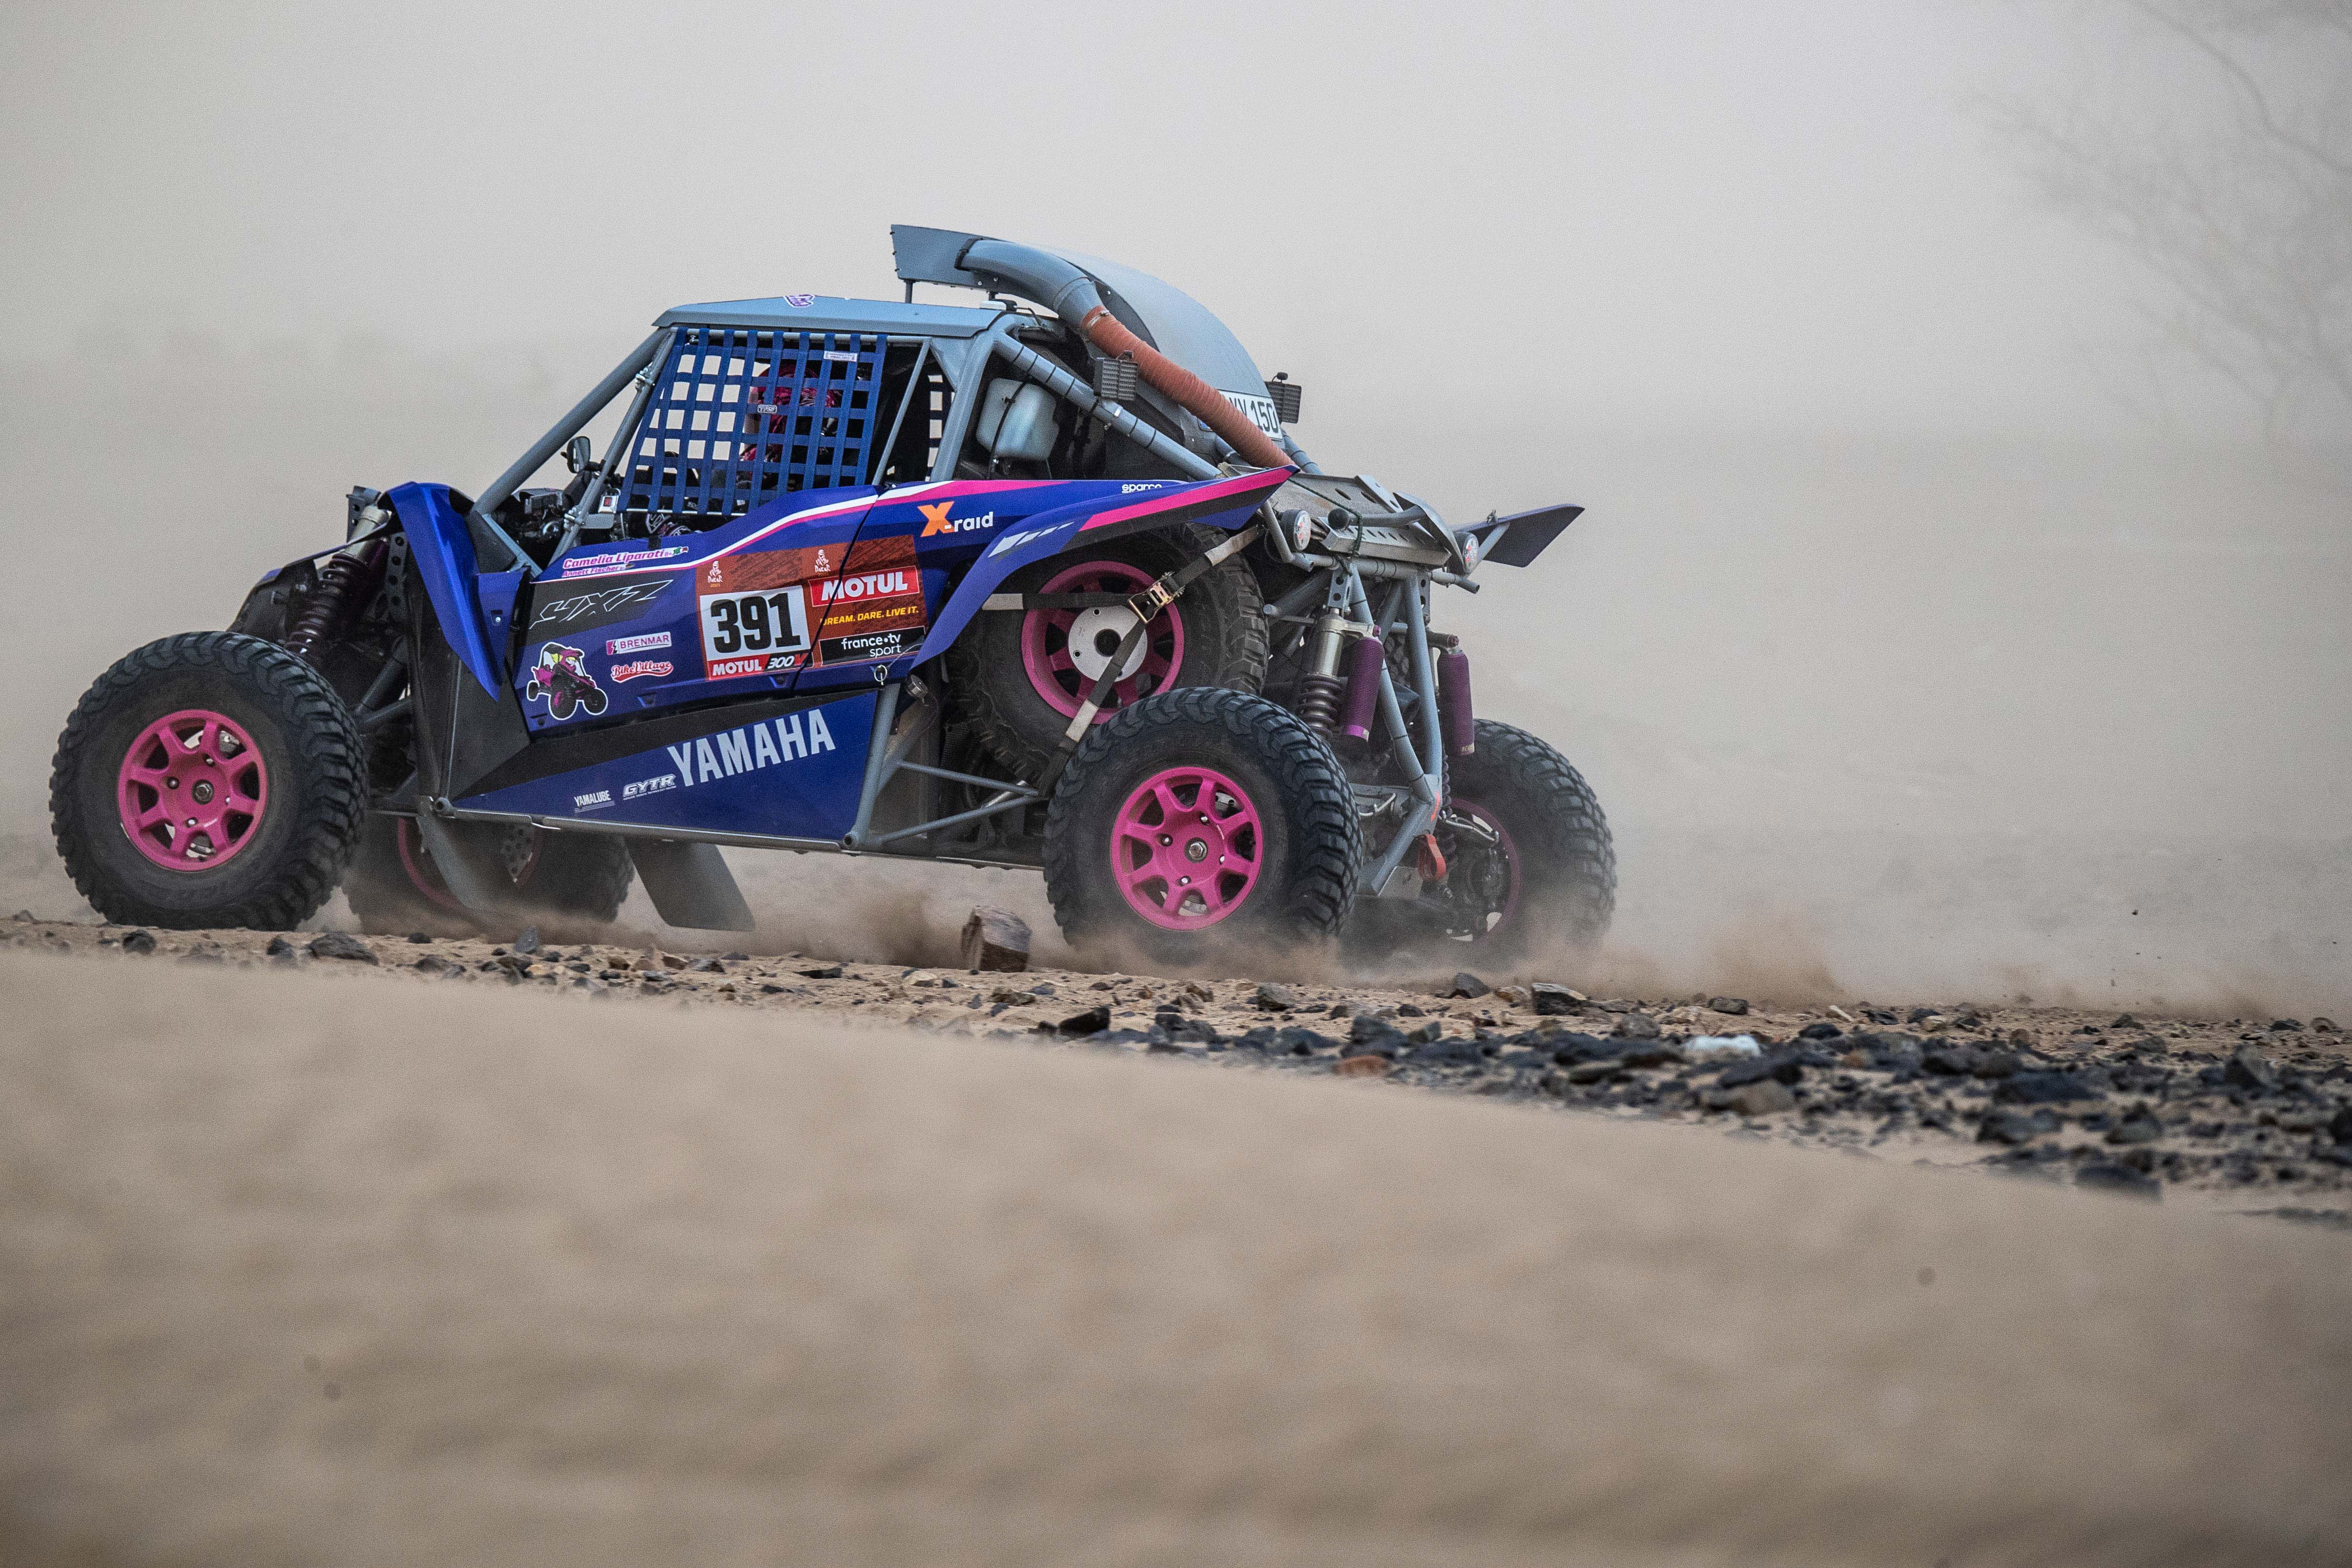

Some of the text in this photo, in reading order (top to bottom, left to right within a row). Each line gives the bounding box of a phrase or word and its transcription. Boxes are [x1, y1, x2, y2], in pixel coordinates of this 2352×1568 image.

[1250, 400, 1279, 433] 150
[917, 501, 993, 537] X-raid
[564, 555, 613, 568] Camelia
[821, 571, 908, 601] MOTUL
[711, 592, 802, 653] 391
[857, 610, 884, 621] DARE.
[886, 607, 906, 617] LIVE
[908, 606, 918, 614] IT.
[620, 635, 670, 649] BRENMAR
[869, 644, 902, 658] sport
[712, 659, 763, 676] MOTUL
[667, 709, 836, 787] YAMAHA
[623, 774, 676, 797] GYTR
[574, 790, 609, 807] YAMALUBE
